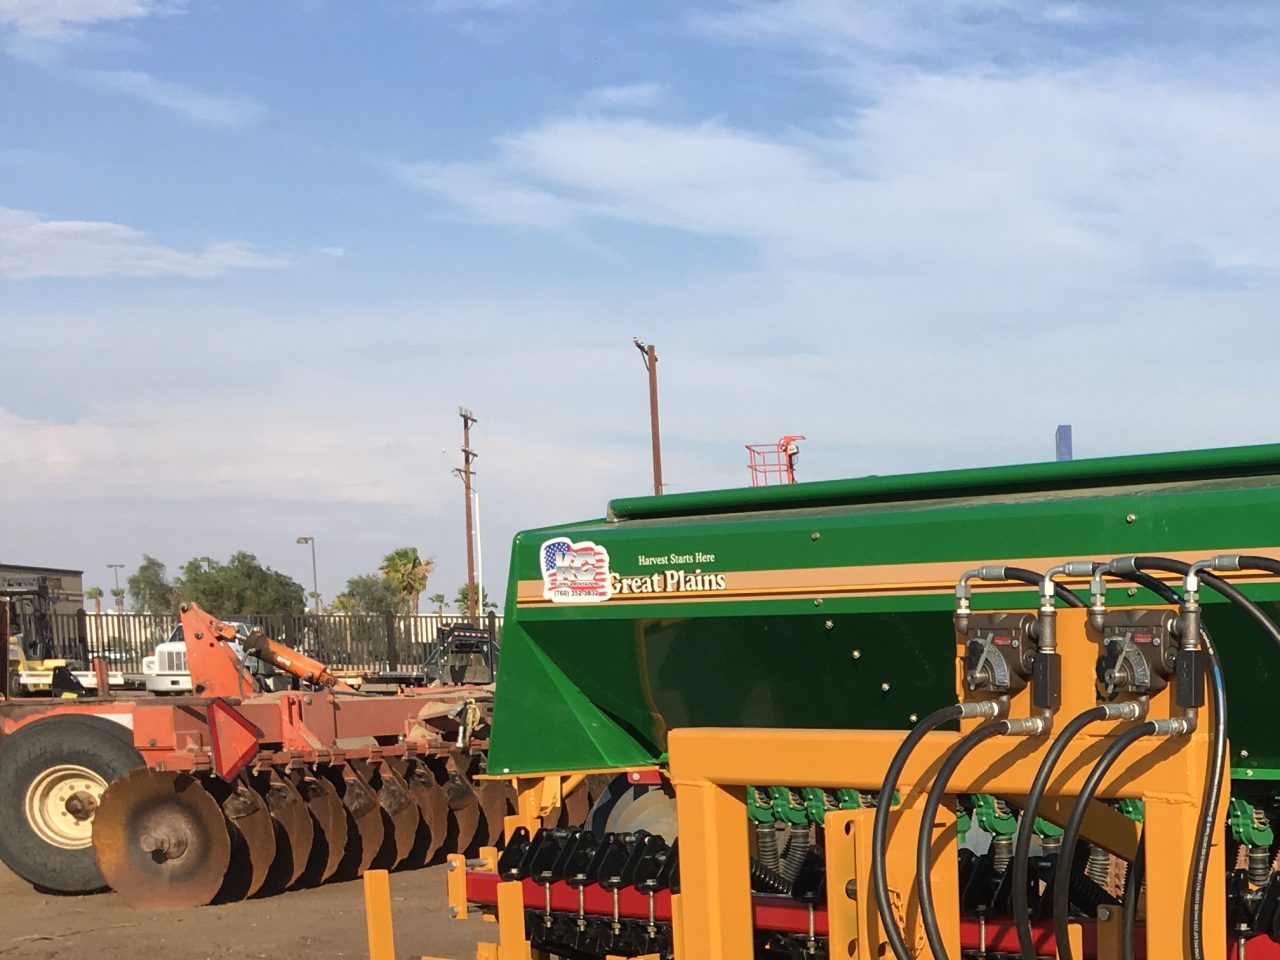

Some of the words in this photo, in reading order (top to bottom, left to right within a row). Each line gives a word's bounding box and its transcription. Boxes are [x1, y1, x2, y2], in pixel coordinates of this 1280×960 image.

[555, 551, 597, 581] KC
[638, 555, 669, 566] Harvest
[670, 553, 694, 564] Starts
[695, 552, 716, 563] Here
[609, 572, 662, 594] Great
[664, 569, 726, 592] Plains
